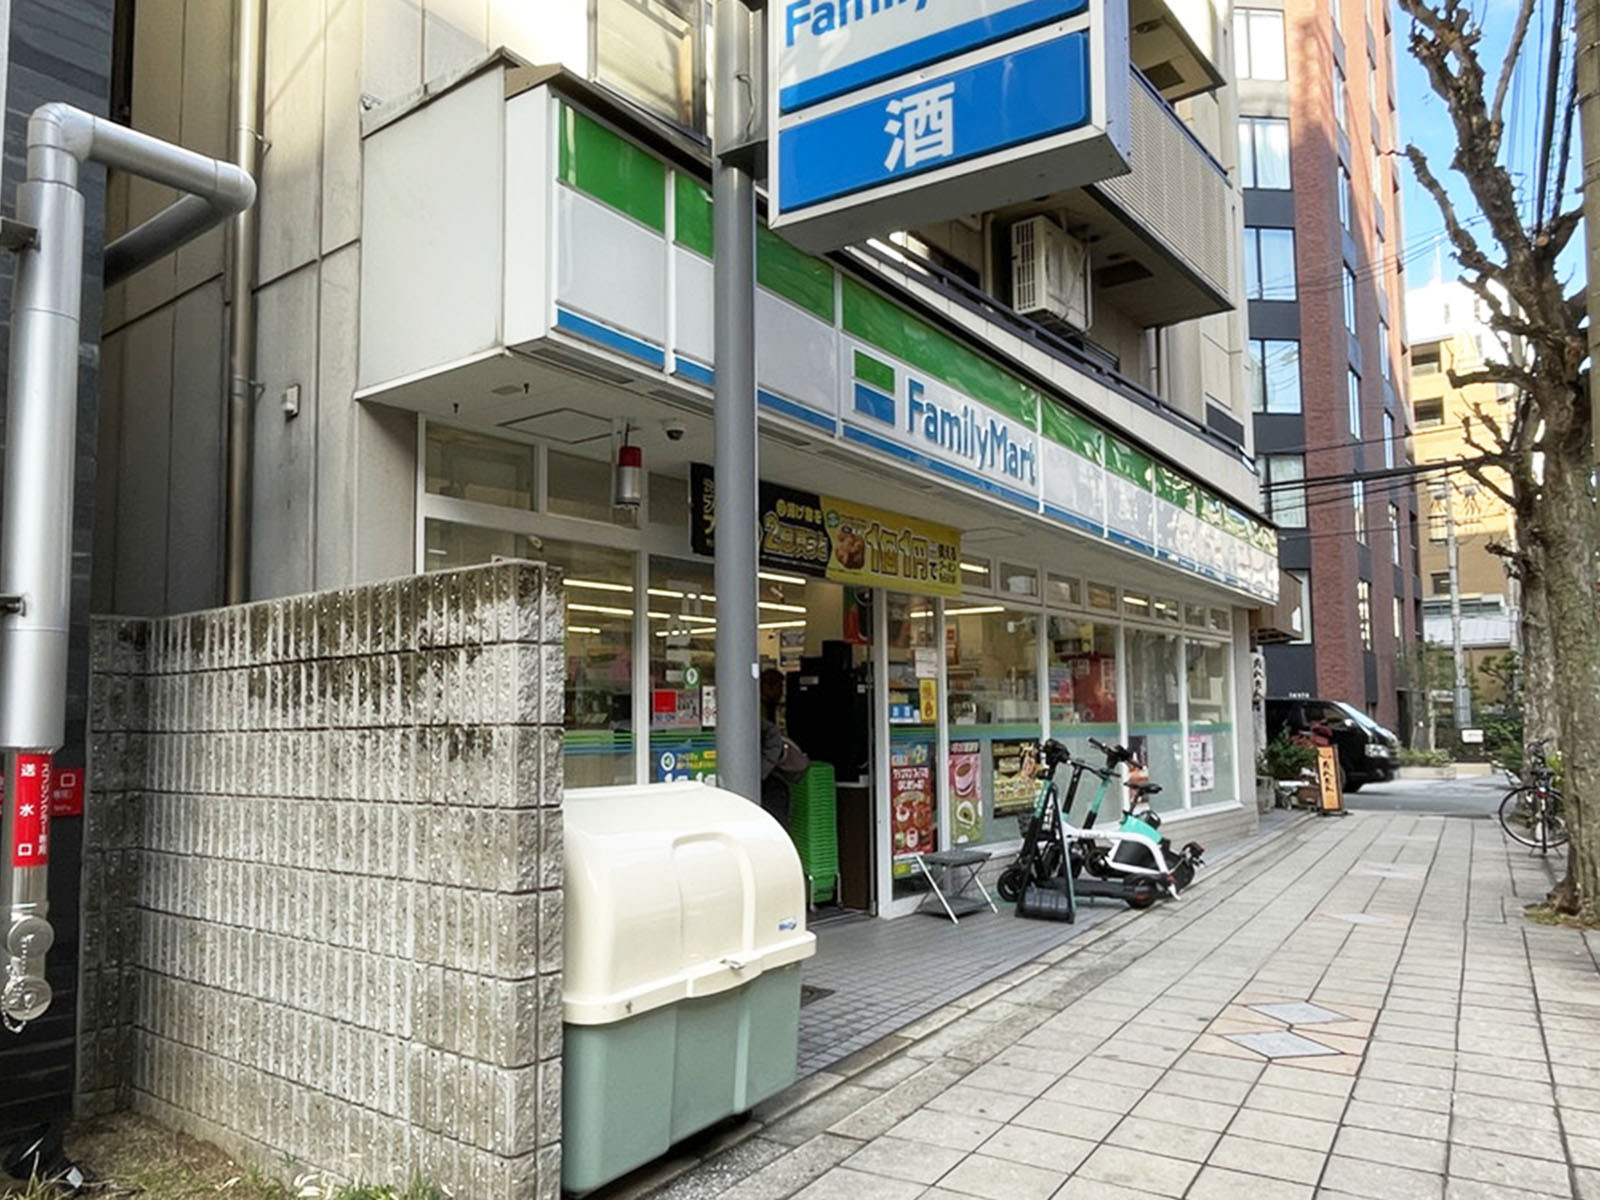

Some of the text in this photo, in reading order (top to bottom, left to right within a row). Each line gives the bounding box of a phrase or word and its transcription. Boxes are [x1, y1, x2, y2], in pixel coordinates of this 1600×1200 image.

[786, 0, 927, 47] Fam
[883, 81, 956, 172] 酒
[906, 376, 1036, 486] FamilyMart
[18, 763, 36, 856] 送水口
